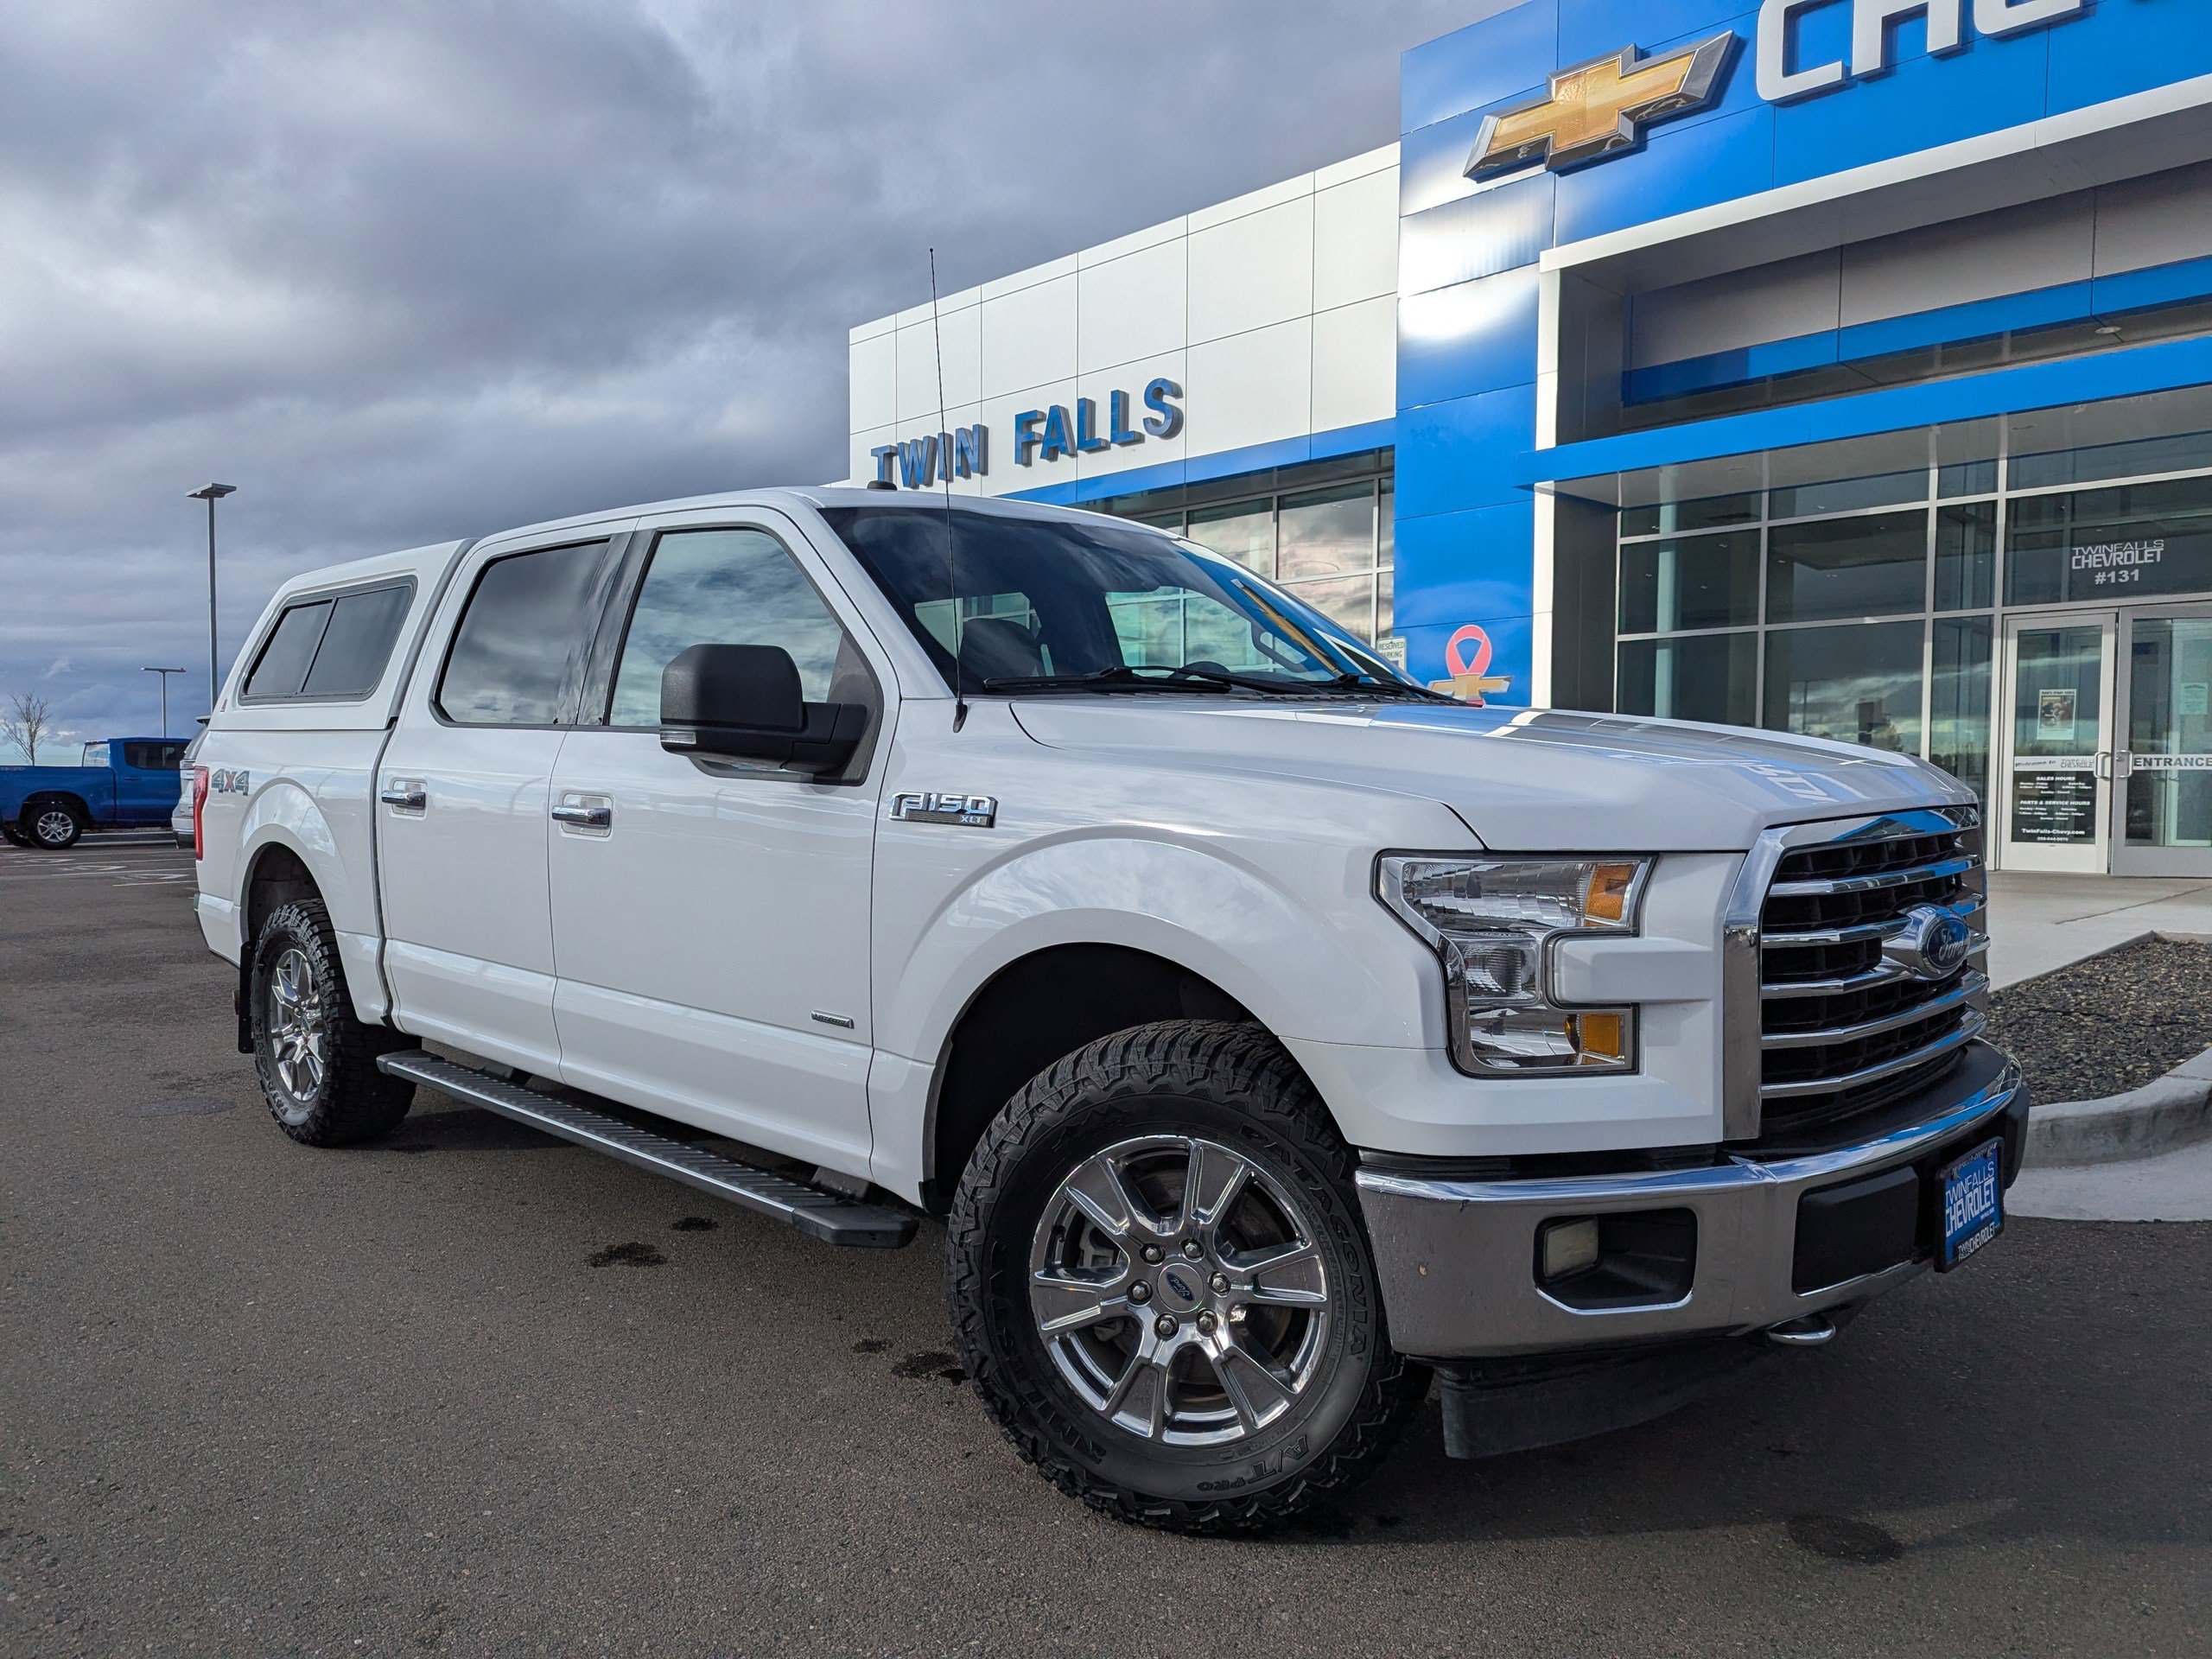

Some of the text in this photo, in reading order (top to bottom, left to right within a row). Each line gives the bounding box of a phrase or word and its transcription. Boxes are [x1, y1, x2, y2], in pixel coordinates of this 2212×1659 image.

[871, 378, 1184, 489] TWIN FALLS
[2073, 539, 2164, 556] TWINFALLS
[2071, 548, 2164, 569] CHEVROLET
[2095, 569, 2139, 585] #131
[1379, 641, 1405, 650] RESERVED
[2133, 757, 2212, 767] ENTRANCE
[211, 768, 250, 796] 4X4
[961, 816, 982, 824] XLT
[1938, 927, 1966, 962] Ford
[1945, 1160, 1995, 1208] TWINFALLS
[1945, 1177, 1996, 1238] CHEVROLET
[1171, 1277, 1191, 1297] Ford
